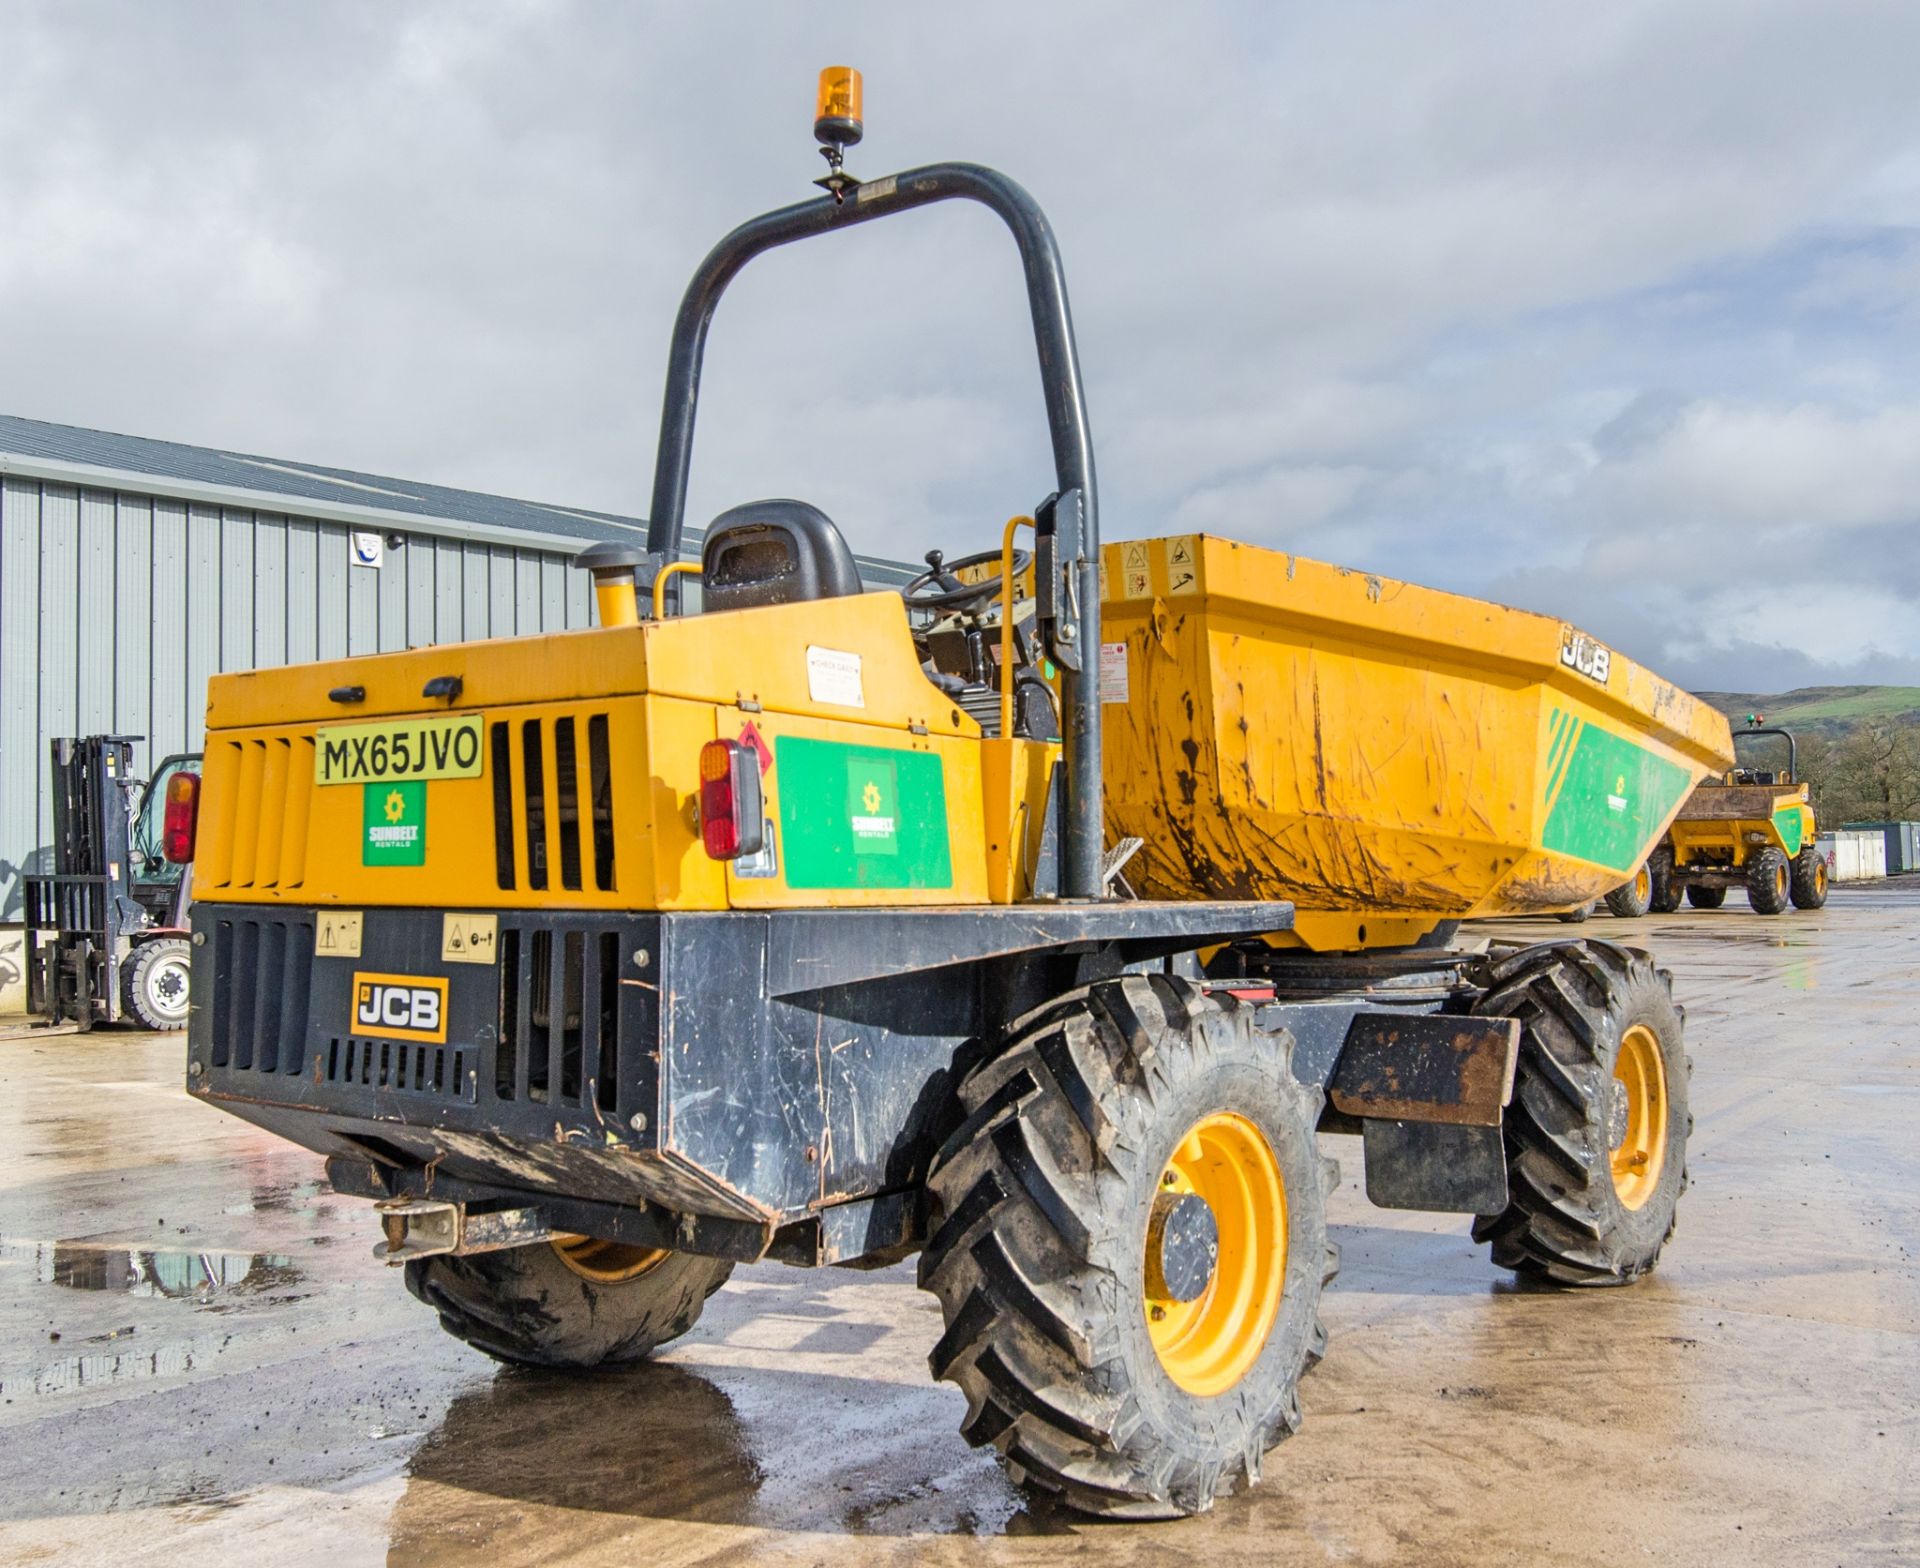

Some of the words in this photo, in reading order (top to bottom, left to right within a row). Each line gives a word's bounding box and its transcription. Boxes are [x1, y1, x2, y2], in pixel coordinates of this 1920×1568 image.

[325, 726, 478, 780] MX65JVO
[369, 826, 418, 842] SUNBELT
[360, 986, 439, 1029] JCB
